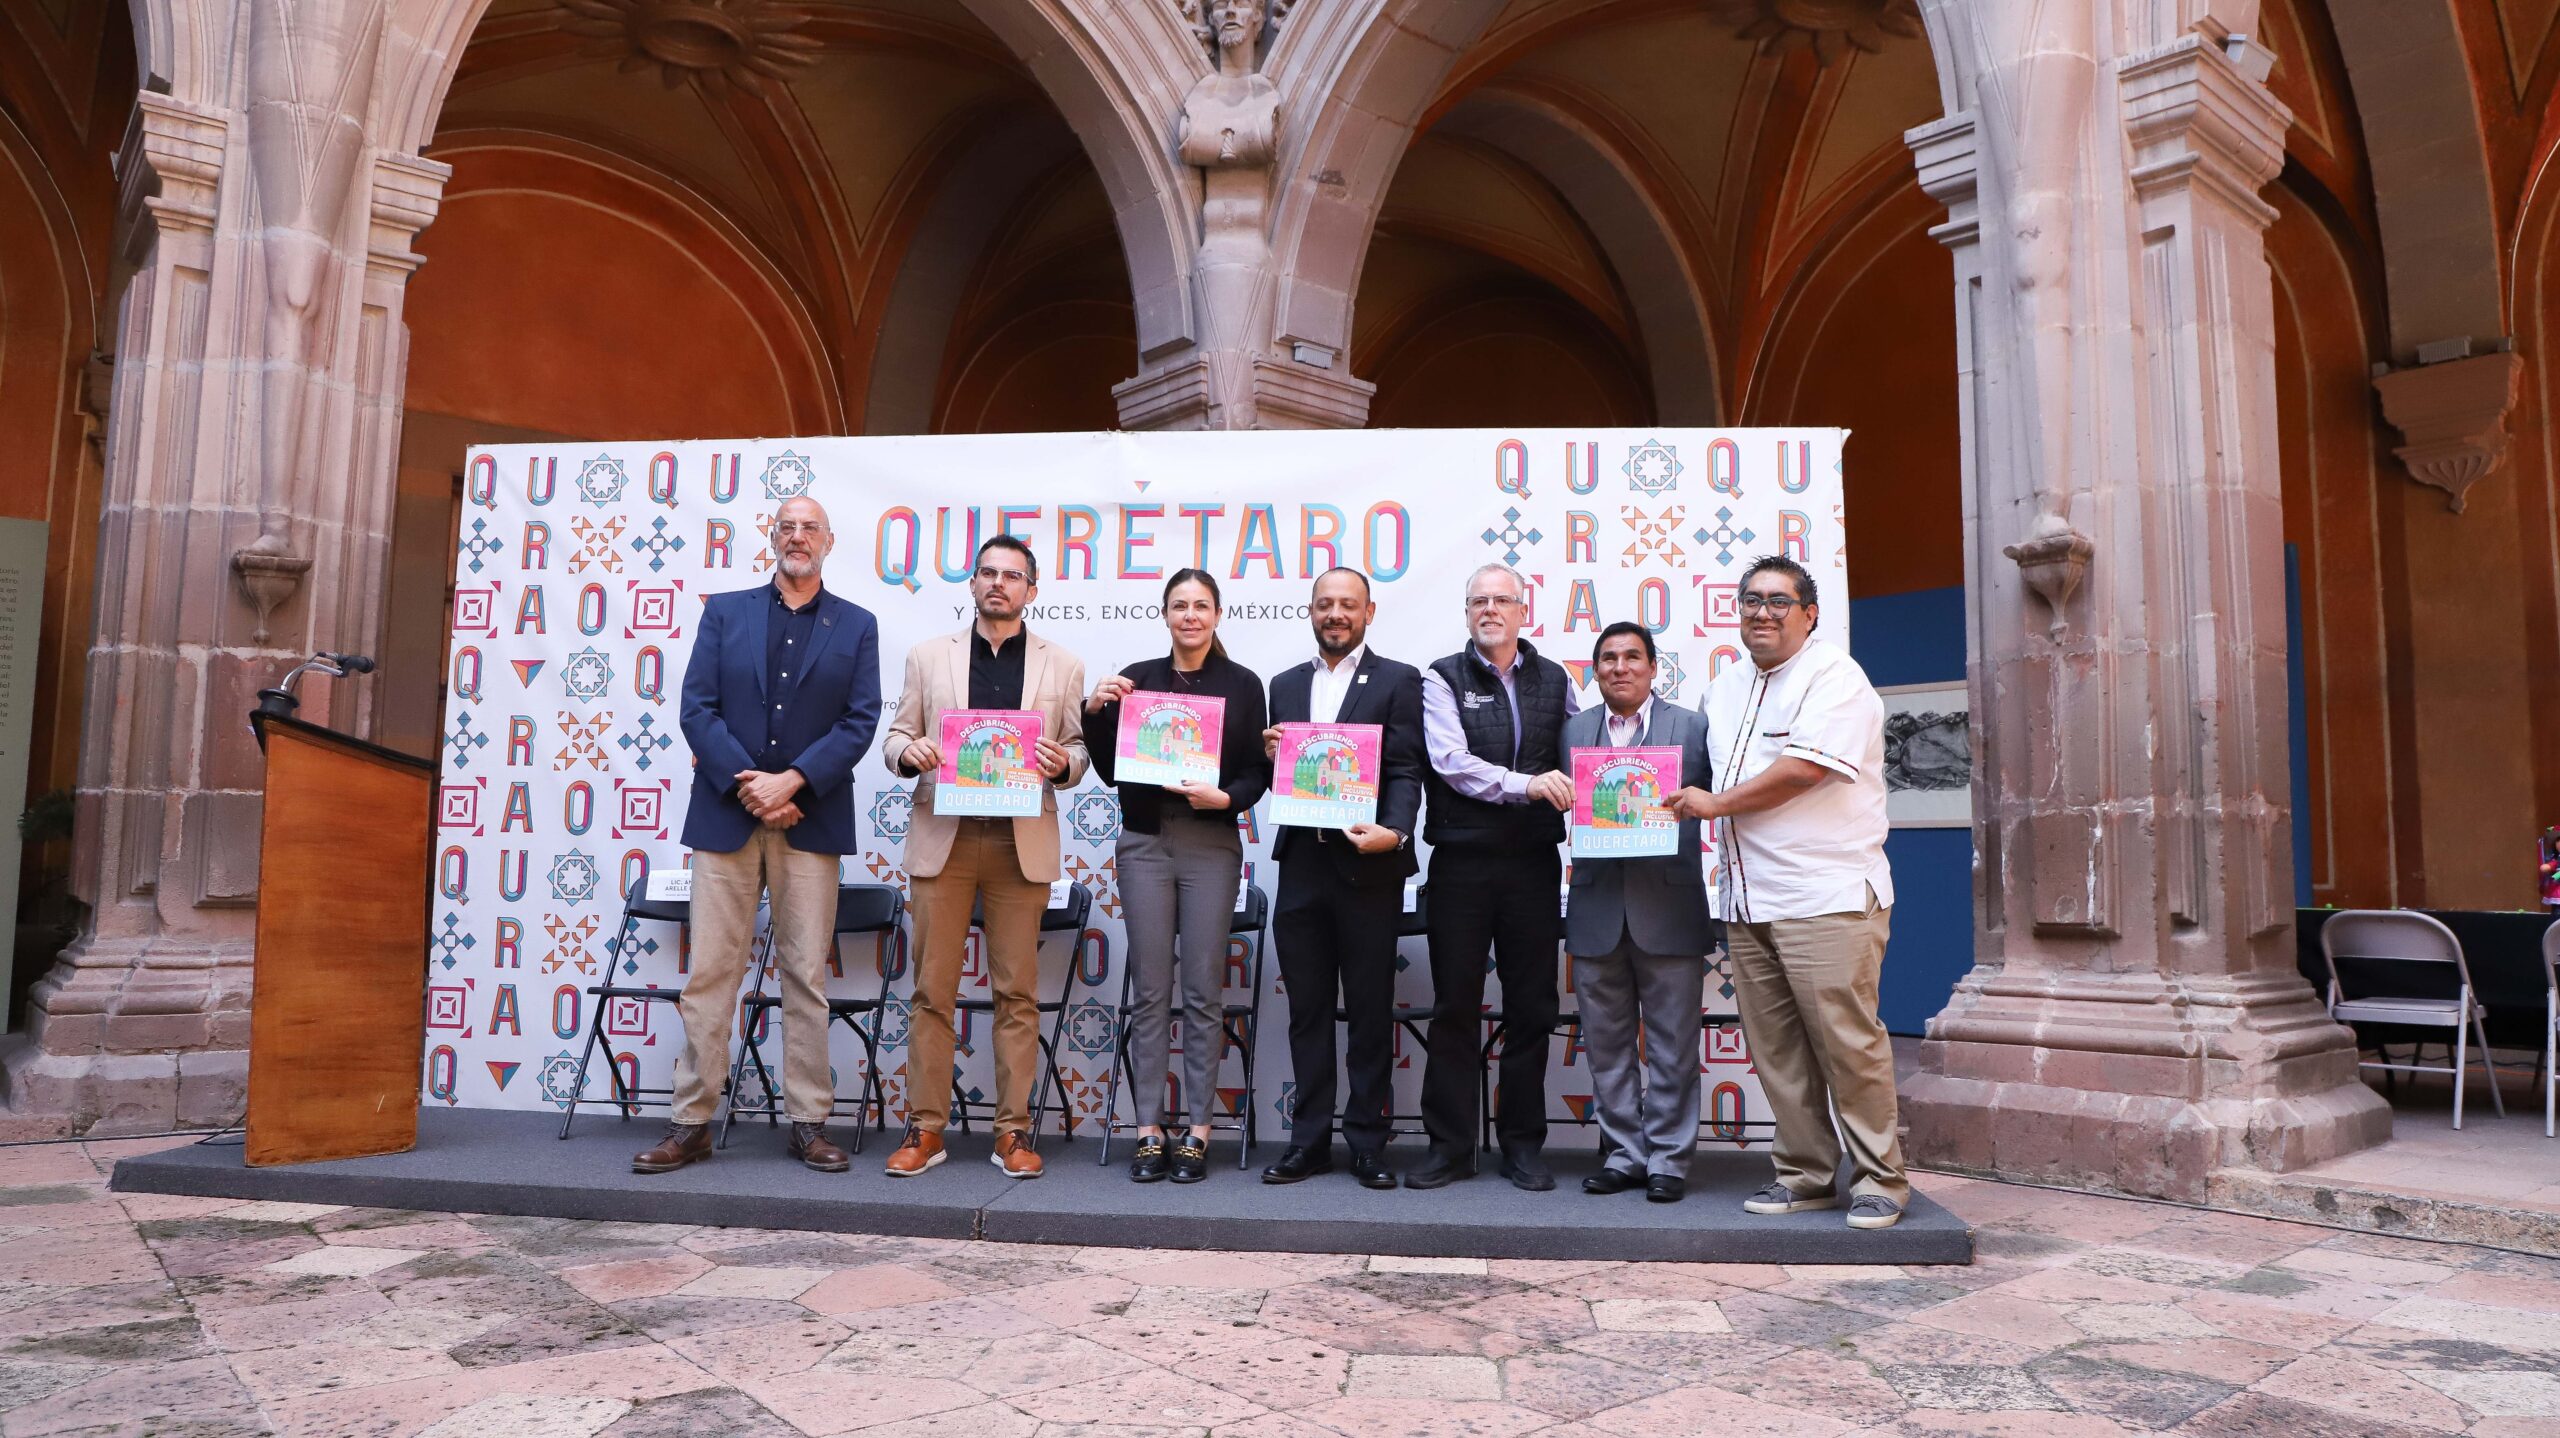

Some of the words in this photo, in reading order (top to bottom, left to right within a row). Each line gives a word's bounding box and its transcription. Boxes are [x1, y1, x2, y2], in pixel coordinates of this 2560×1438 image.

[468, 453, 498, 510] Q
[527, 457, 557, 506] U
[648, 451, 679, 510] Q
[709, 453, 741, 505] U
[1496, 438, 1532, 500] Q
[1566, 441, 1598, 495] U
[1707, 437, 1744, 500] Q
[1777, 440, 1811, 495] U
[521, 520, 552, 570] R
[704, 518, 736, 568] R
[1566, 510, 1599, 563] R
[1778, 509, 1812, 562] R
[515, 584, 547, 635] A
[577, 582, 607, 637] O
[953, 606, 965, 620] Y
[1227, 602, 1311, 620] MÉXICO
[1563, 579, 1602, 633] A
[1637, 577, 1671, 635] O
[453, 645, 484, 705] Q
[634, 645, 667, 706] Q
[959, 719, 1022, 738] DESCUBRIENDO
[1140, 702, 1202, 722] DESCUBRIENDO
[507, 715, 538, 767] R
[1296, 733, 1359, 751] DESCUBRIENDO
[1592, 757, 1659, 778] DESCUBRIENDO
[501, 782, 533, 833] A
[564, 781, 594, 836] O
[440, 845, 469, 906] Q
[499, 849, 528, 902] U
[494, 916, 525, 969] R
[488, 983, 522, 1037] A
[552, 983, 582, 1040] O
[428, 1044, 460, 1107] Q
